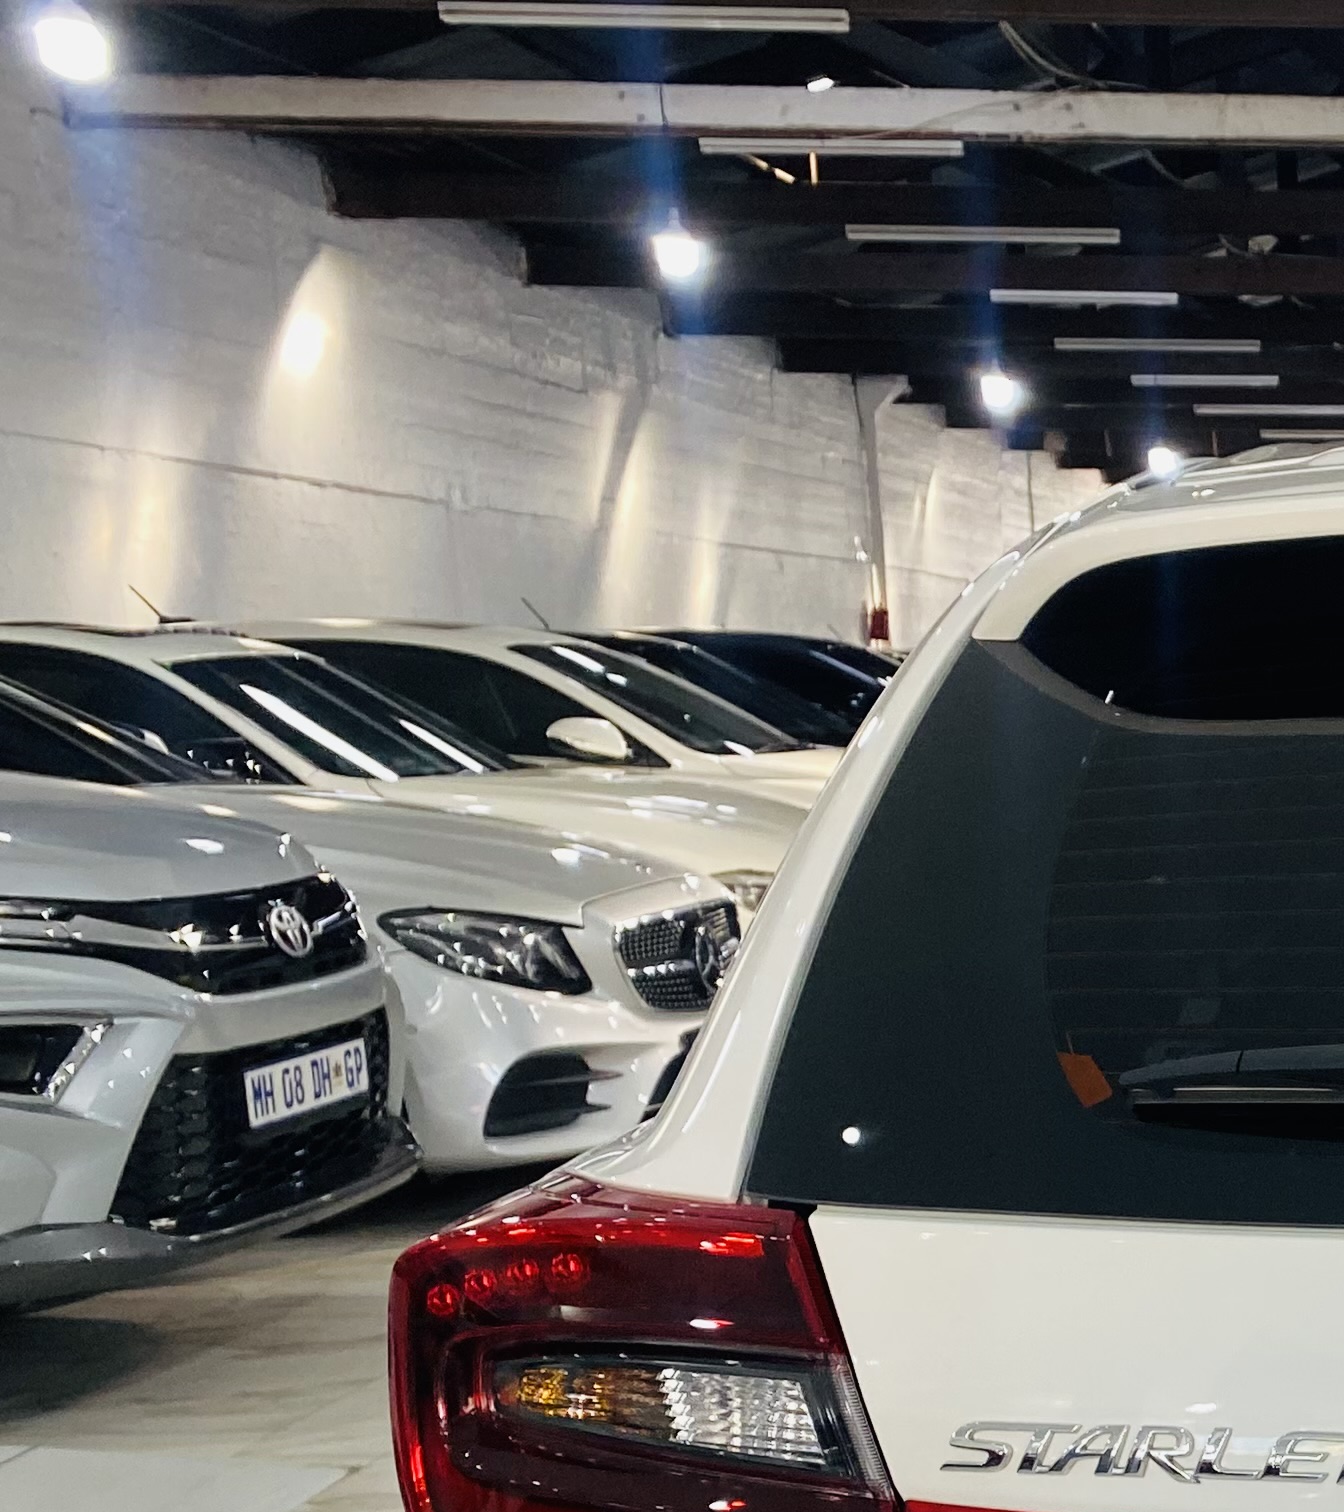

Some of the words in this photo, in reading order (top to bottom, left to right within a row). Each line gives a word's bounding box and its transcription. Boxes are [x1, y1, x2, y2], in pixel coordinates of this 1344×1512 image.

[250, 1072, 276, 1119] MH
[281, 1064, 305, 1109] 08
[310, 1056, 332, 1099] DH
[343, 1046, 363, 1089] GP
